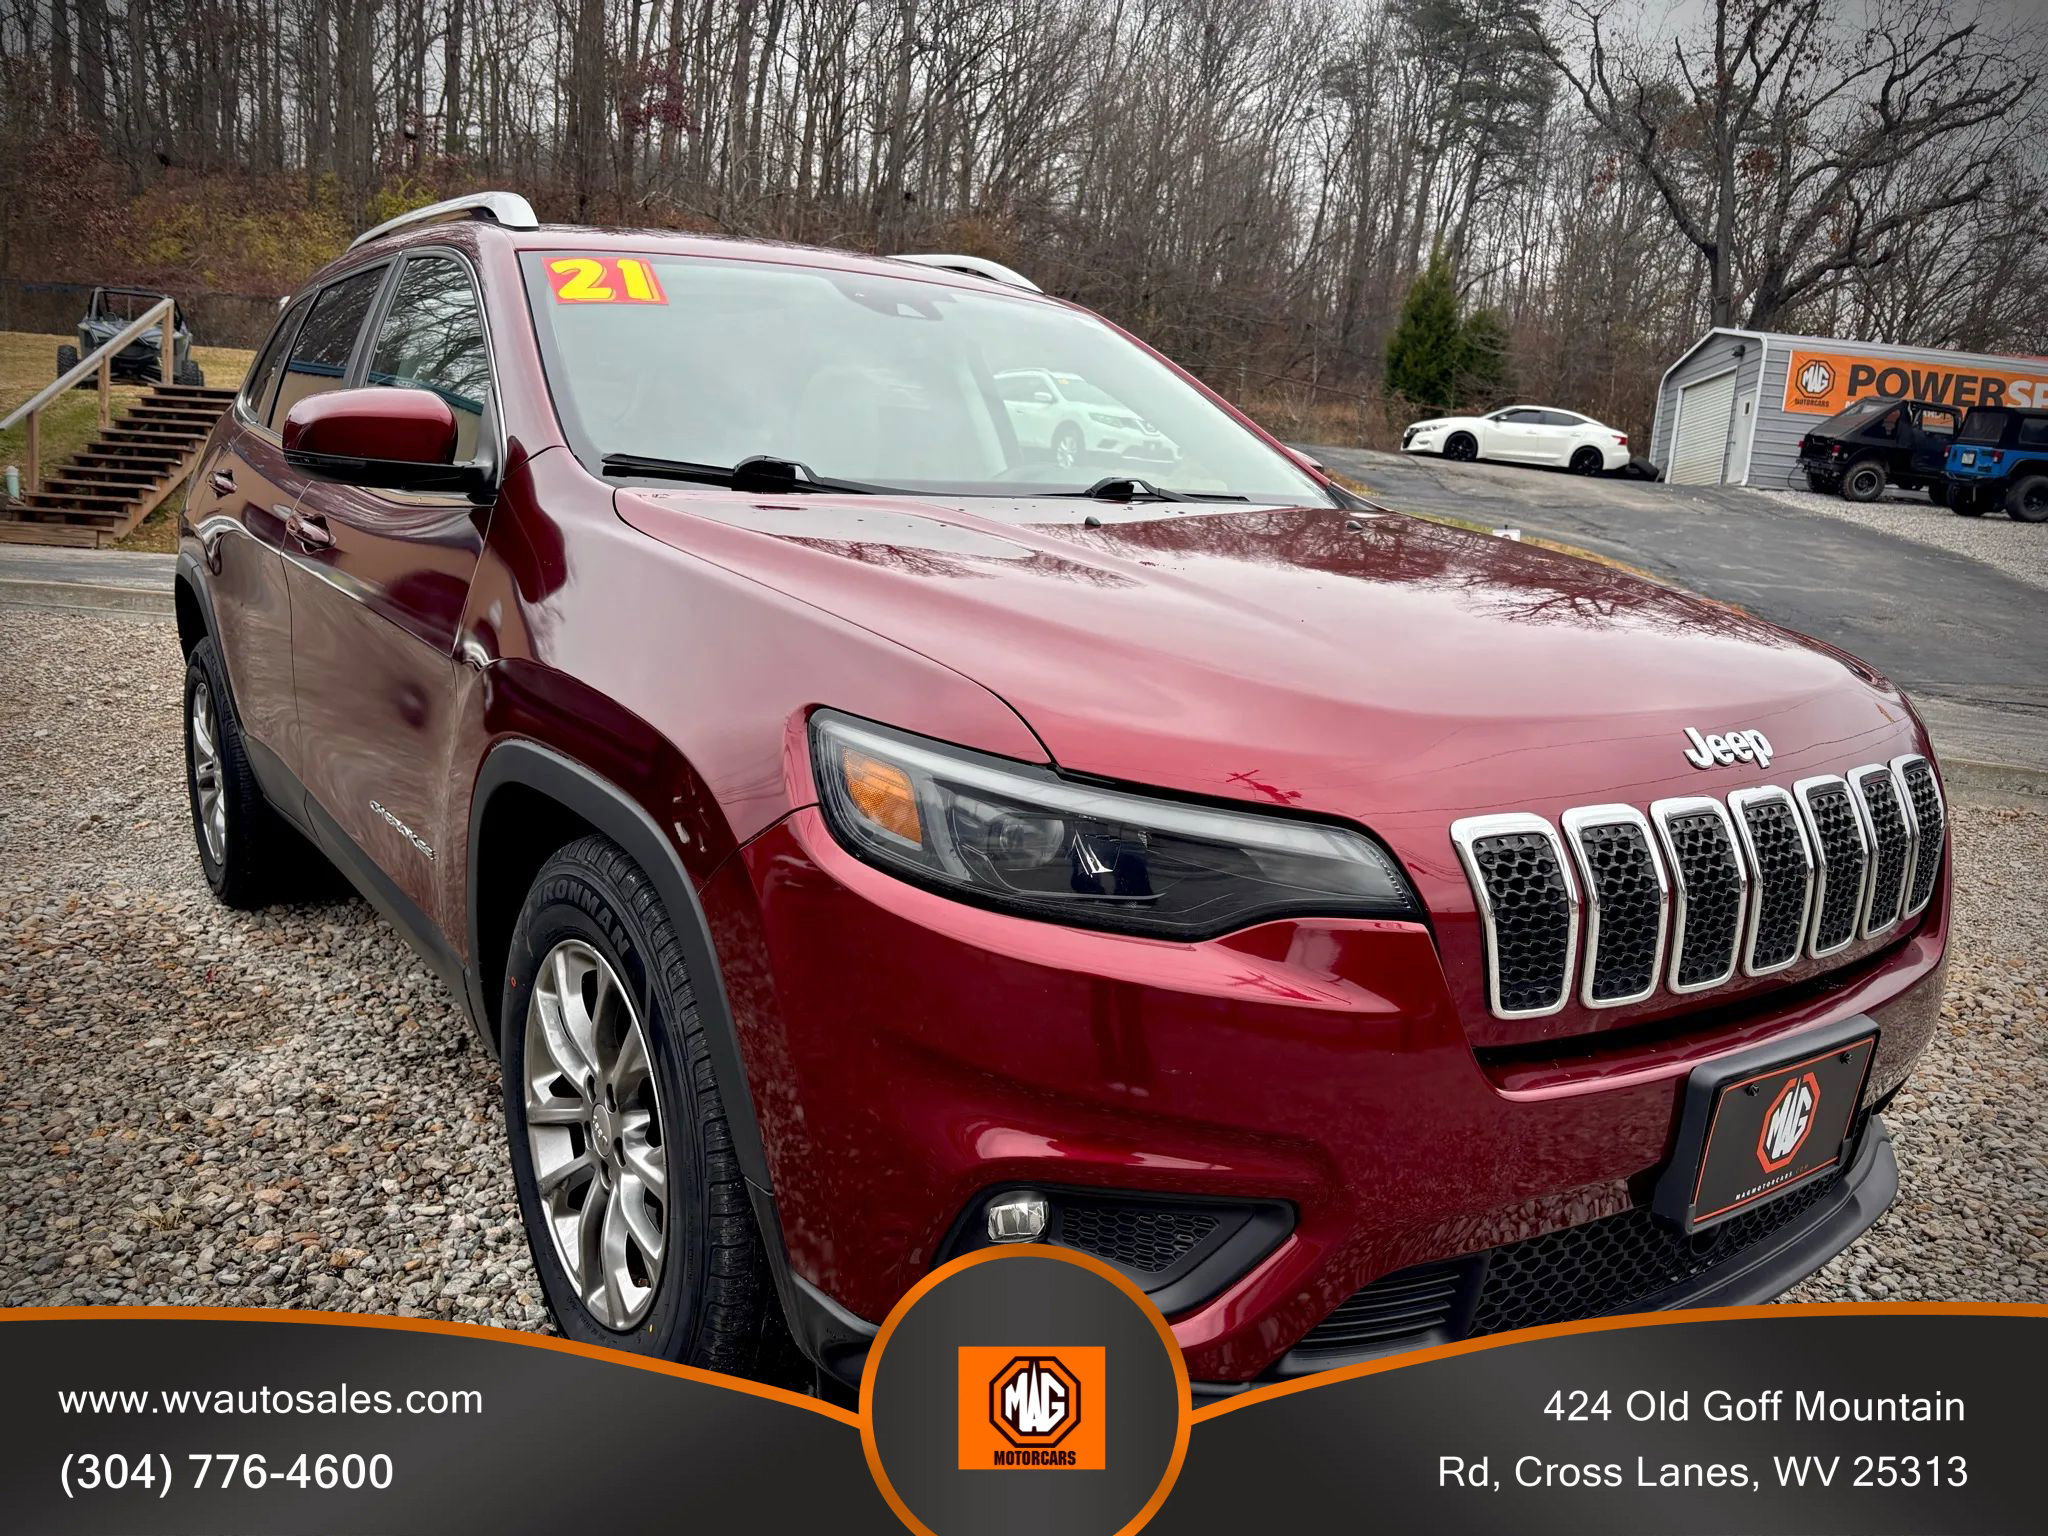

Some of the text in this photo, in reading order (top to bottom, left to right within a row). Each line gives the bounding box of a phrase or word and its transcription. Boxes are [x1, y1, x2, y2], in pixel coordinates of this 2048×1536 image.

[550, 258, 660, 302] 21
[1802, 362, 1830, 393] MAG
[1682, 727, 1774, 770] Jeep
[535, 879, 631, 958] IRONMAN
[1765, 1077, 1813, 1160] MAG
